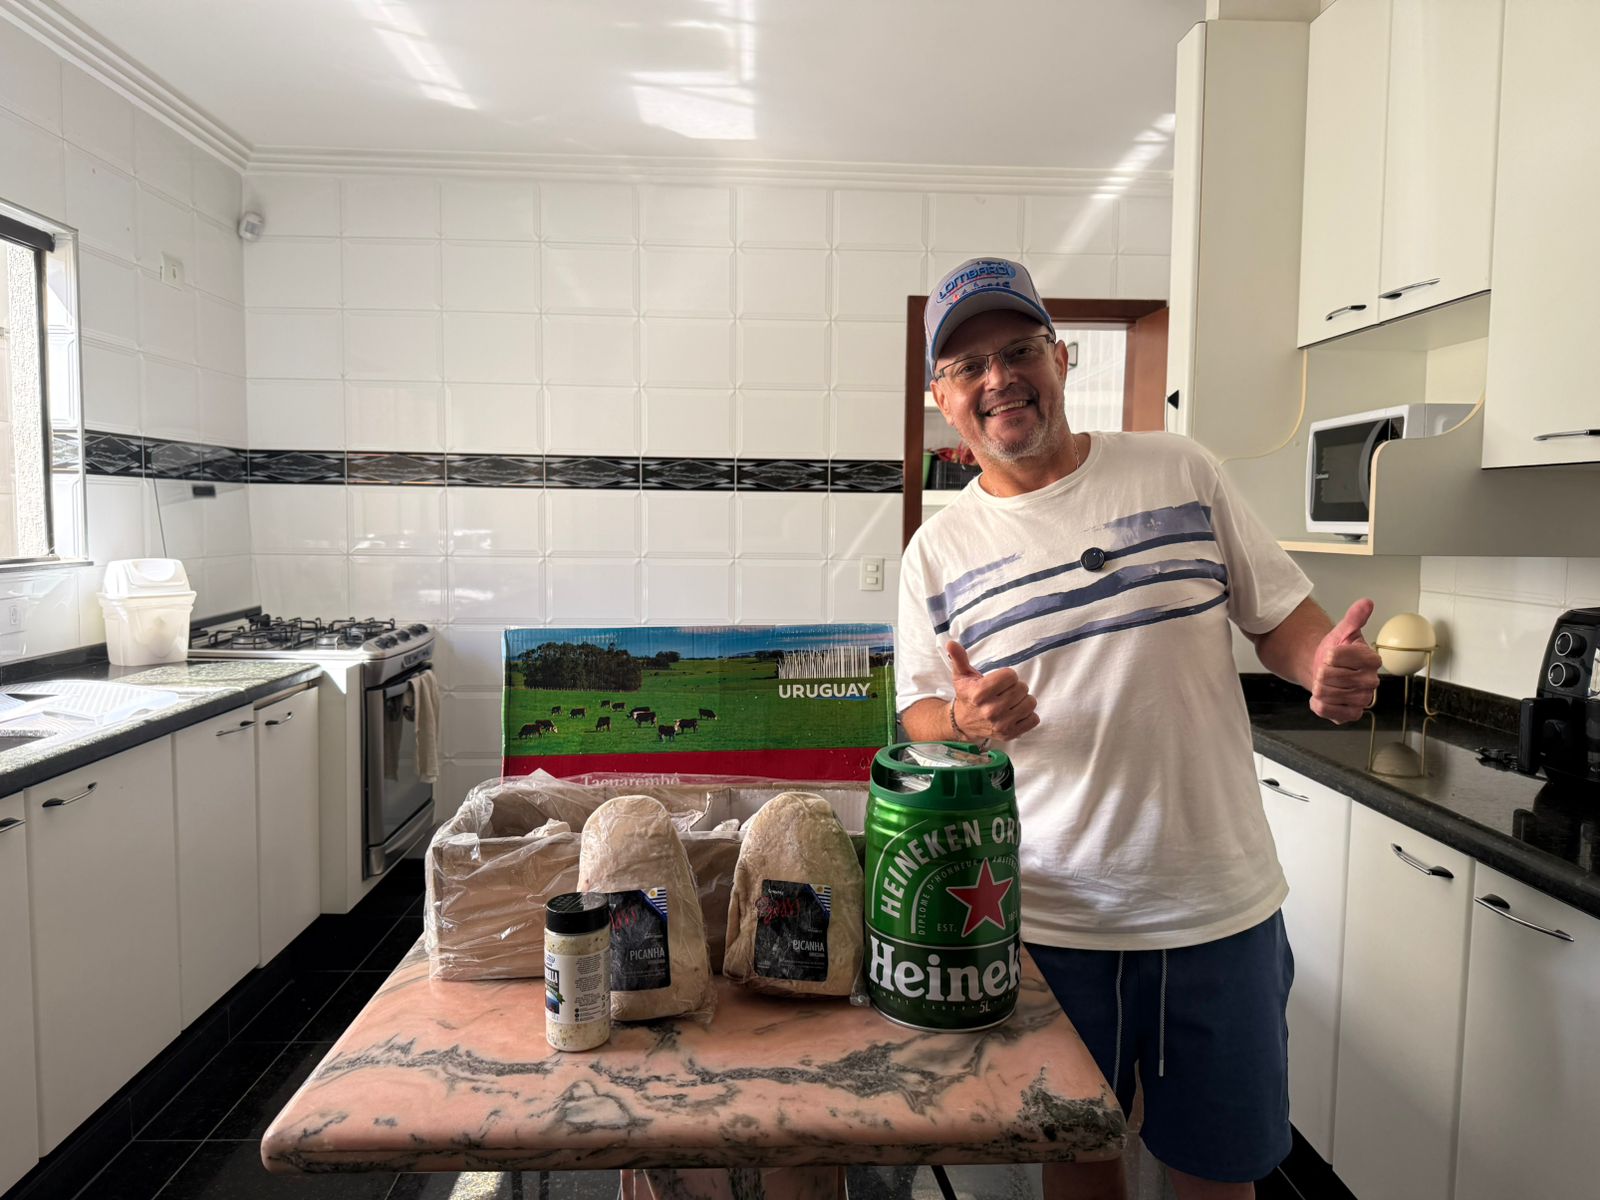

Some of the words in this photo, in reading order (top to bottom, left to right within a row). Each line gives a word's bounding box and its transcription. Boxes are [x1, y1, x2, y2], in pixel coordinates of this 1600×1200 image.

[778, 683, 871, 699] URUGUAY
[880, 818, 982, 919] HEINEKEN
[937, 923, 957, 932] EST.
[792, 939, 825, 952] PICANHA
[629, 947, 666, 961] PICANHA
[978, 1001, 991, 1014] 5L
